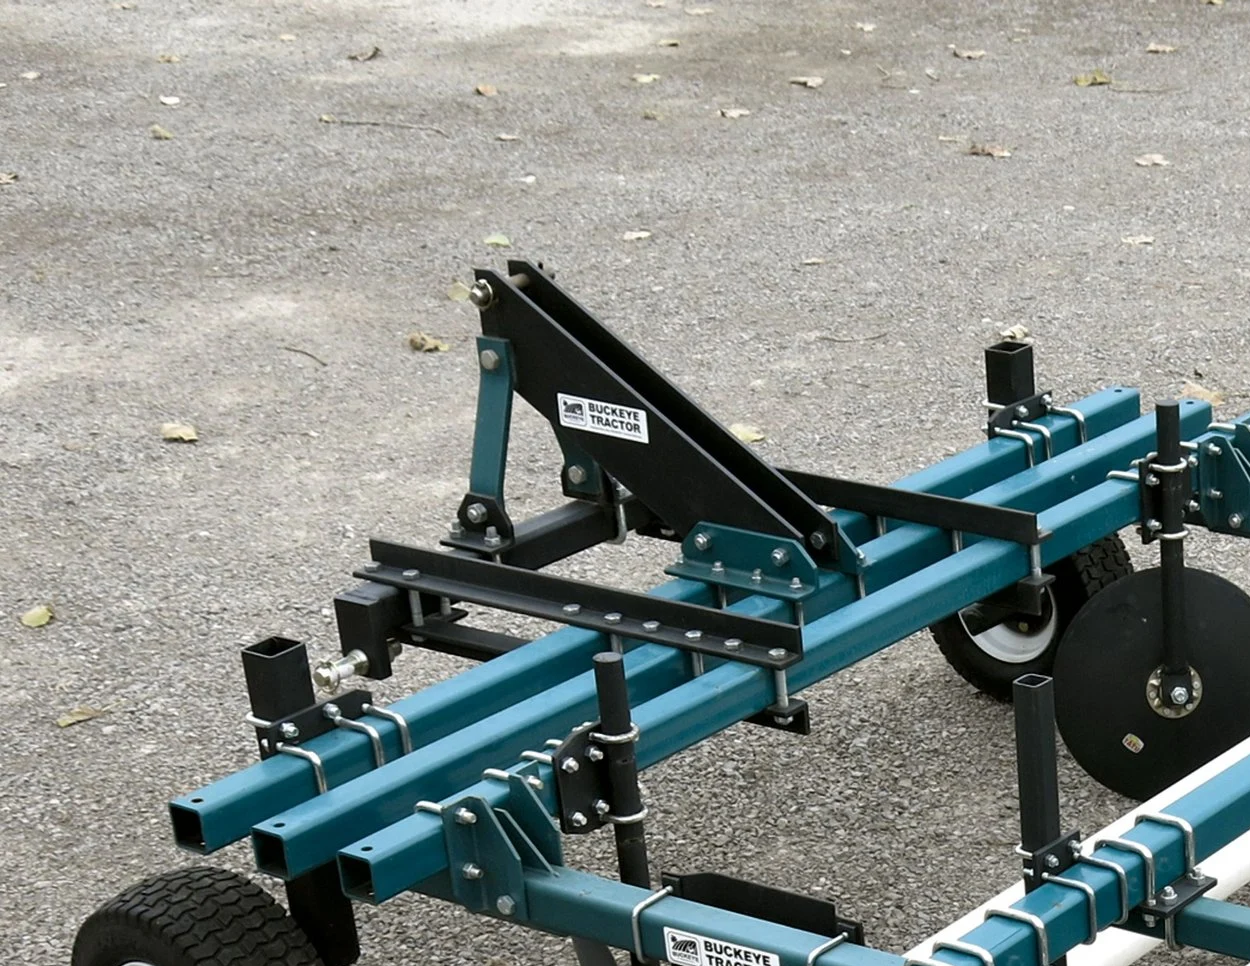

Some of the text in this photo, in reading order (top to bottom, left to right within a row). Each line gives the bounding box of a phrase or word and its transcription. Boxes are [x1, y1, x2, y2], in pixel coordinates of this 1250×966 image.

[588, 402, 640, 421] BUCKEYE
[589, 414, 641, 433] TRACTOR
[703, 940, 771, 966] BUCKEYE
